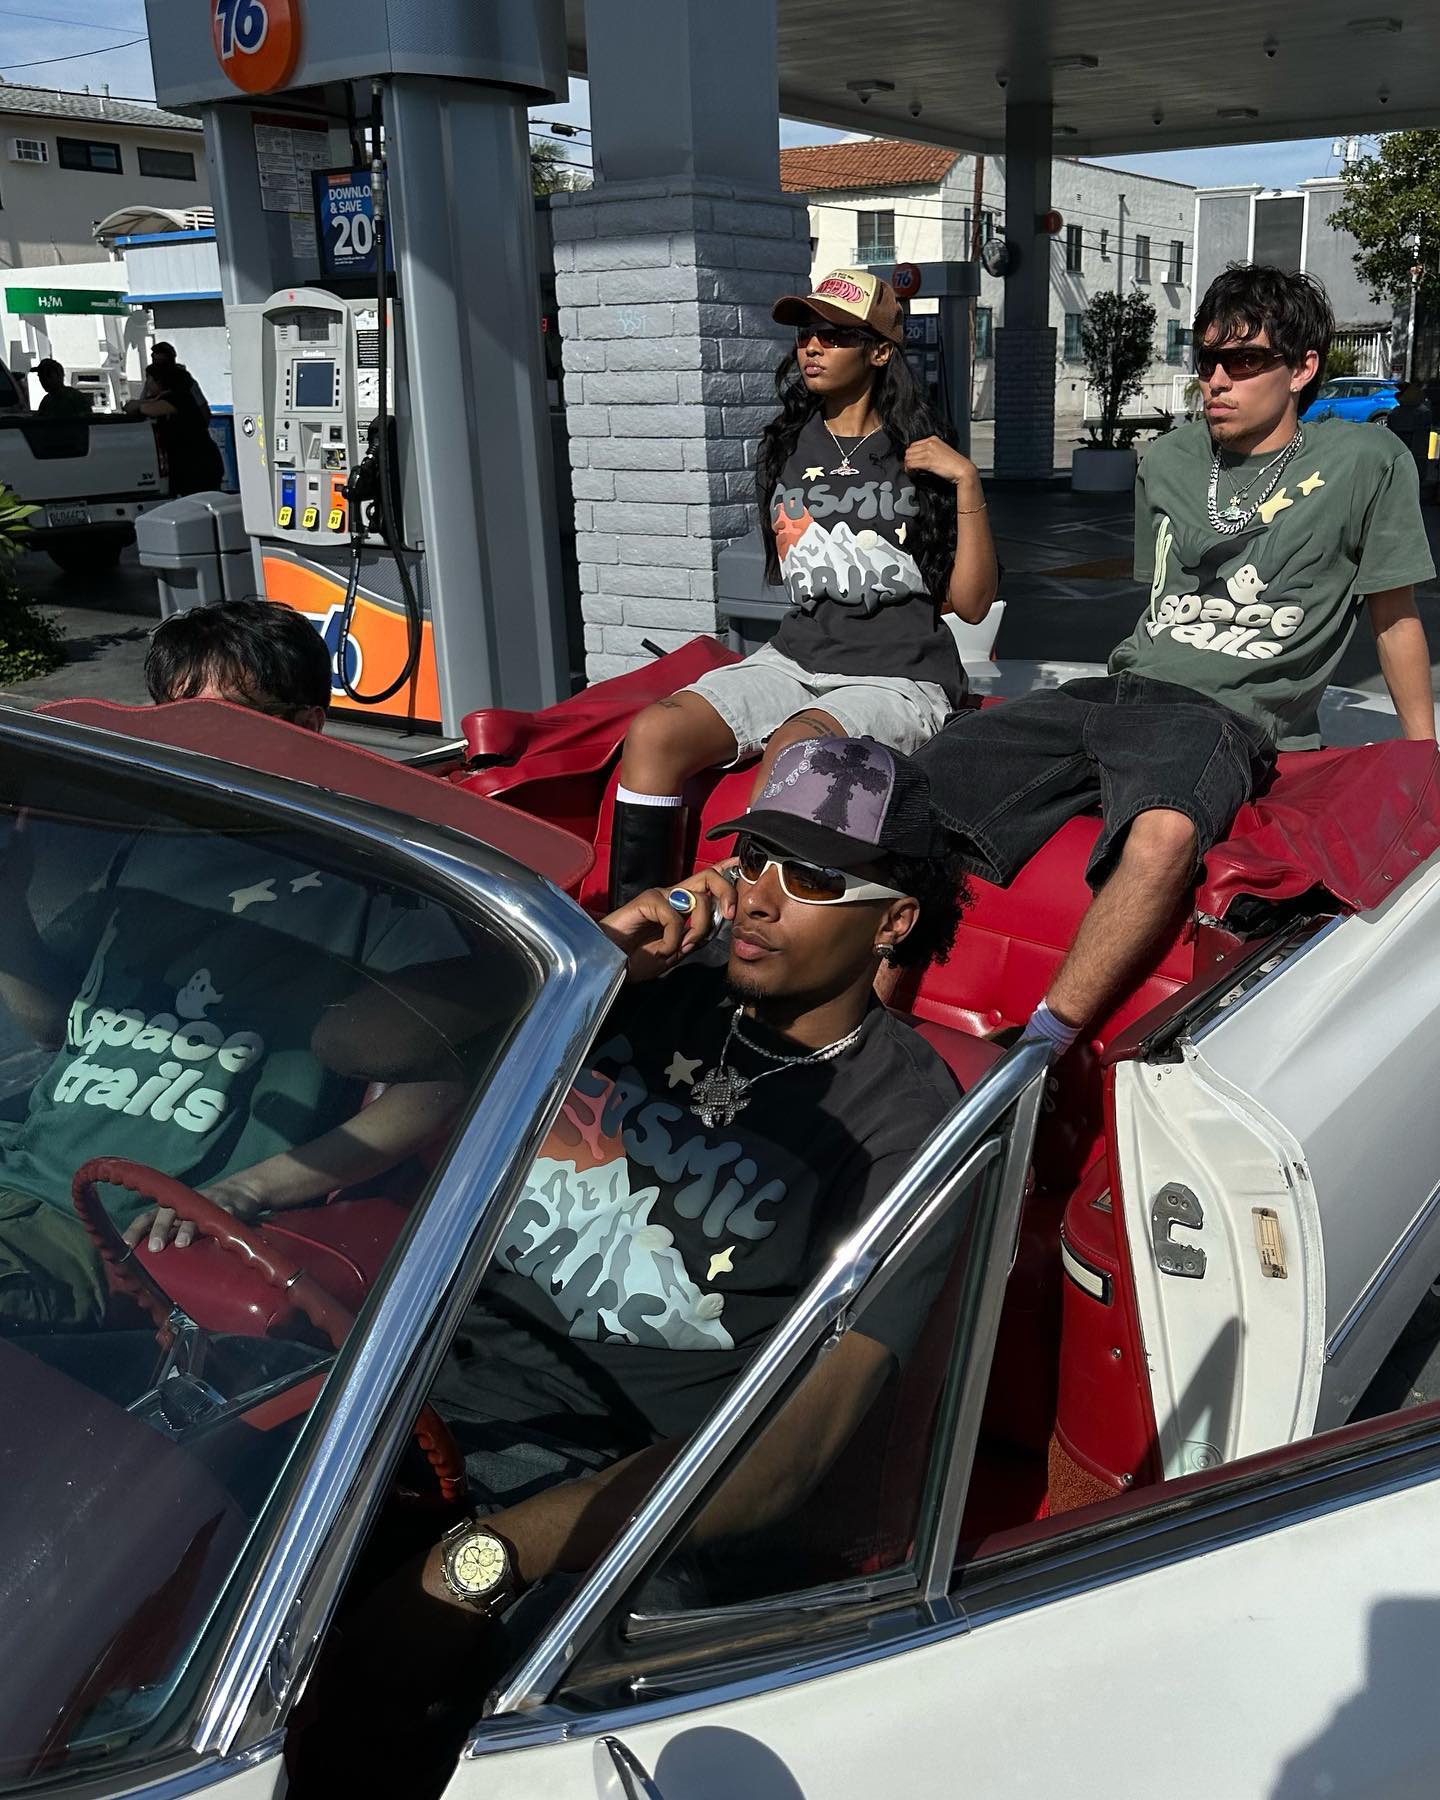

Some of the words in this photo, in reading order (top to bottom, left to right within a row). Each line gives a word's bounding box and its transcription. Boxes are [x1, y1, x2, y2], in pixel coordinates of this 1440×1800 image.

[215, 0, 268, 60] 76
[329, 185, 372, 201] DOWNLO
[330, 202, 338, 214] &
[339, 200, 362, 213] SAVE
[332, 214, 376, 255] 20
[895, 273, 912, 288] 76
[783, 565, 912, 612] EAKS
[1156, 594, 1305, 638] space
[84, 1006, 265, 1074] space
[53, 1055, 228, 1133] trails
[494, 1198, 672, 1349] EAKS
